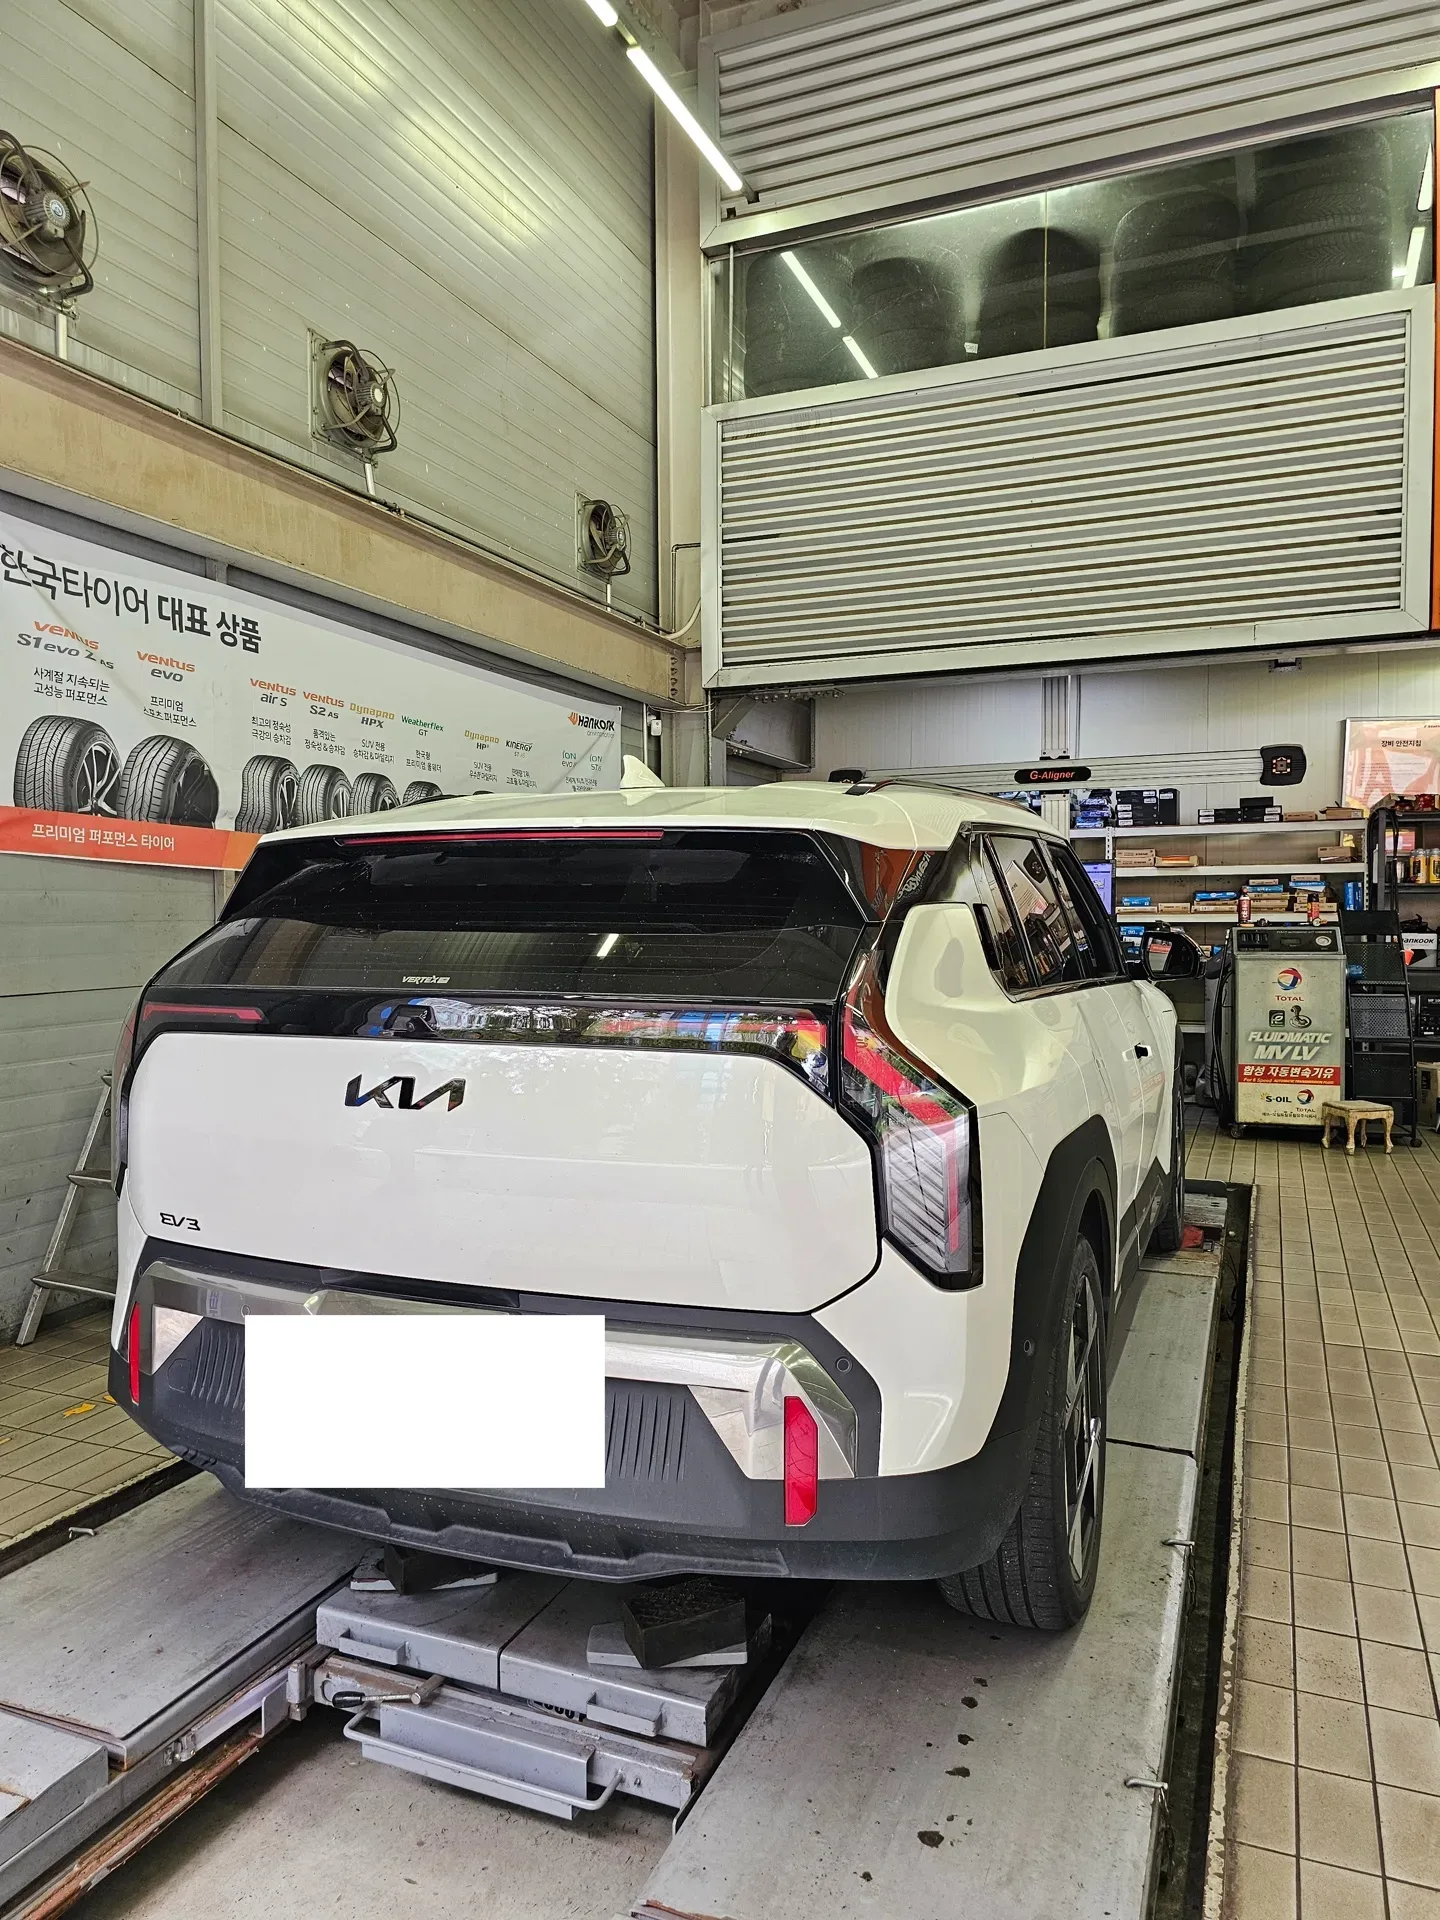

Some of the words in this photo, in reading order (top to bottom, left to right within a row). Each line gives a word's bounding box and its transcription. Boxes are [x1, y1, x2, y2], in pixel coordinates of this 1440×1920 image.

[0, 544, 149, 624] 한국타이어
[157, 594, 211, 637] 대표
[215, 611, 262, 654] 상품
[43, 643, 80, 657] evo
[99, 659, 114, 670] AS
[33, 666, 64, 684] 사계절
[66, 673, 110, 692] 지속되는
[150, 667, 184, 683] evo
[33, 682, 64, 699] 고성능
[65, 688, 108, 706] 퍼포먼스
[260, 692, 279, 704] air
[279, 697, 287, 707] S
[150, 695, 184, 713] 프리미엄
[309, 704, 326, 716] S2
[327, 711, 339, 719] AS
[143, 707, 164, 721] 스포츠
[163, 712, 197, 728] 퍼포먼스
[251, 716, 271, 729] 최고의
[272, 720, 291, 734] 정숙성
[360, 716, 384, 729] HPX
[401, 715, 444, 732] Weatherflex
[252, 728, 272, 742] 극강의
[273, 733, 292, 746] 승차감
[418, 728, 429, 737] GT
[361, 738, 374, 749] SUV
[375, 741, 386, 752] 전용
[1029, 770, 1076, 781] G-Aligner
[31, 823, 85, 844] 프리미엄
[88, 829, 139, 848] 퍼포먼스
[141, 834, 175, 851] 타이어
[402, 975, 439, 985] VERTEX
[1247, 1031, 1332, 1043] FLUIDMATIC
[1253, 1044, 1294, 1060] MV
[1290, 1045, 1321, 1061] LV
[1243, 1065, 1266, 1077] 합성
[1267, 1066, 1335, 1079] 자동변속기유
[344, 1074, 467, 1112] KIA
[1265, 1095, 1292, 1103] S-OIL
[159, 1212, 201, 1231] EV3
